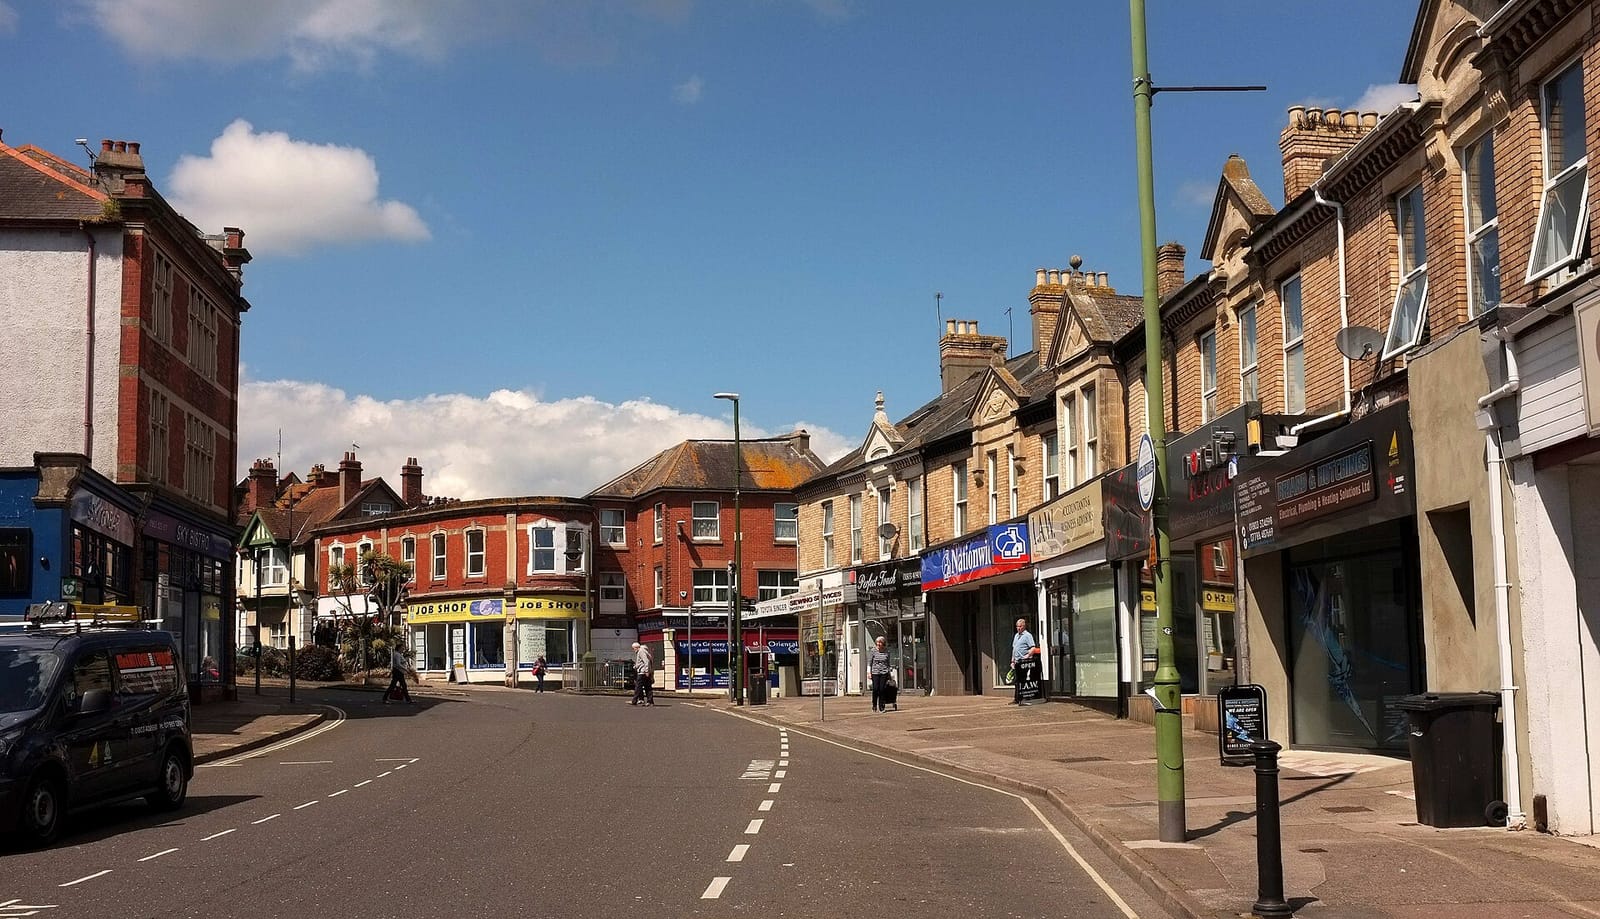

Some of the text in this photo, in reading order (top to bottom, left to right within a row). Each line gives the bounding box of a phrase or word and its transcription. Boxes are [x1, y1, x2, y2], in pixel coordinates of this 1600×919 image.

[1317, 448, 1369, 488] HUTCHINGS
[1340, 485, 1361, 500] Solutions
[1361, 480, 1370, 493] Ltd
[416, 603, 467, 615] JOB SHOP
[789, 596, 813, 607] SEWING
